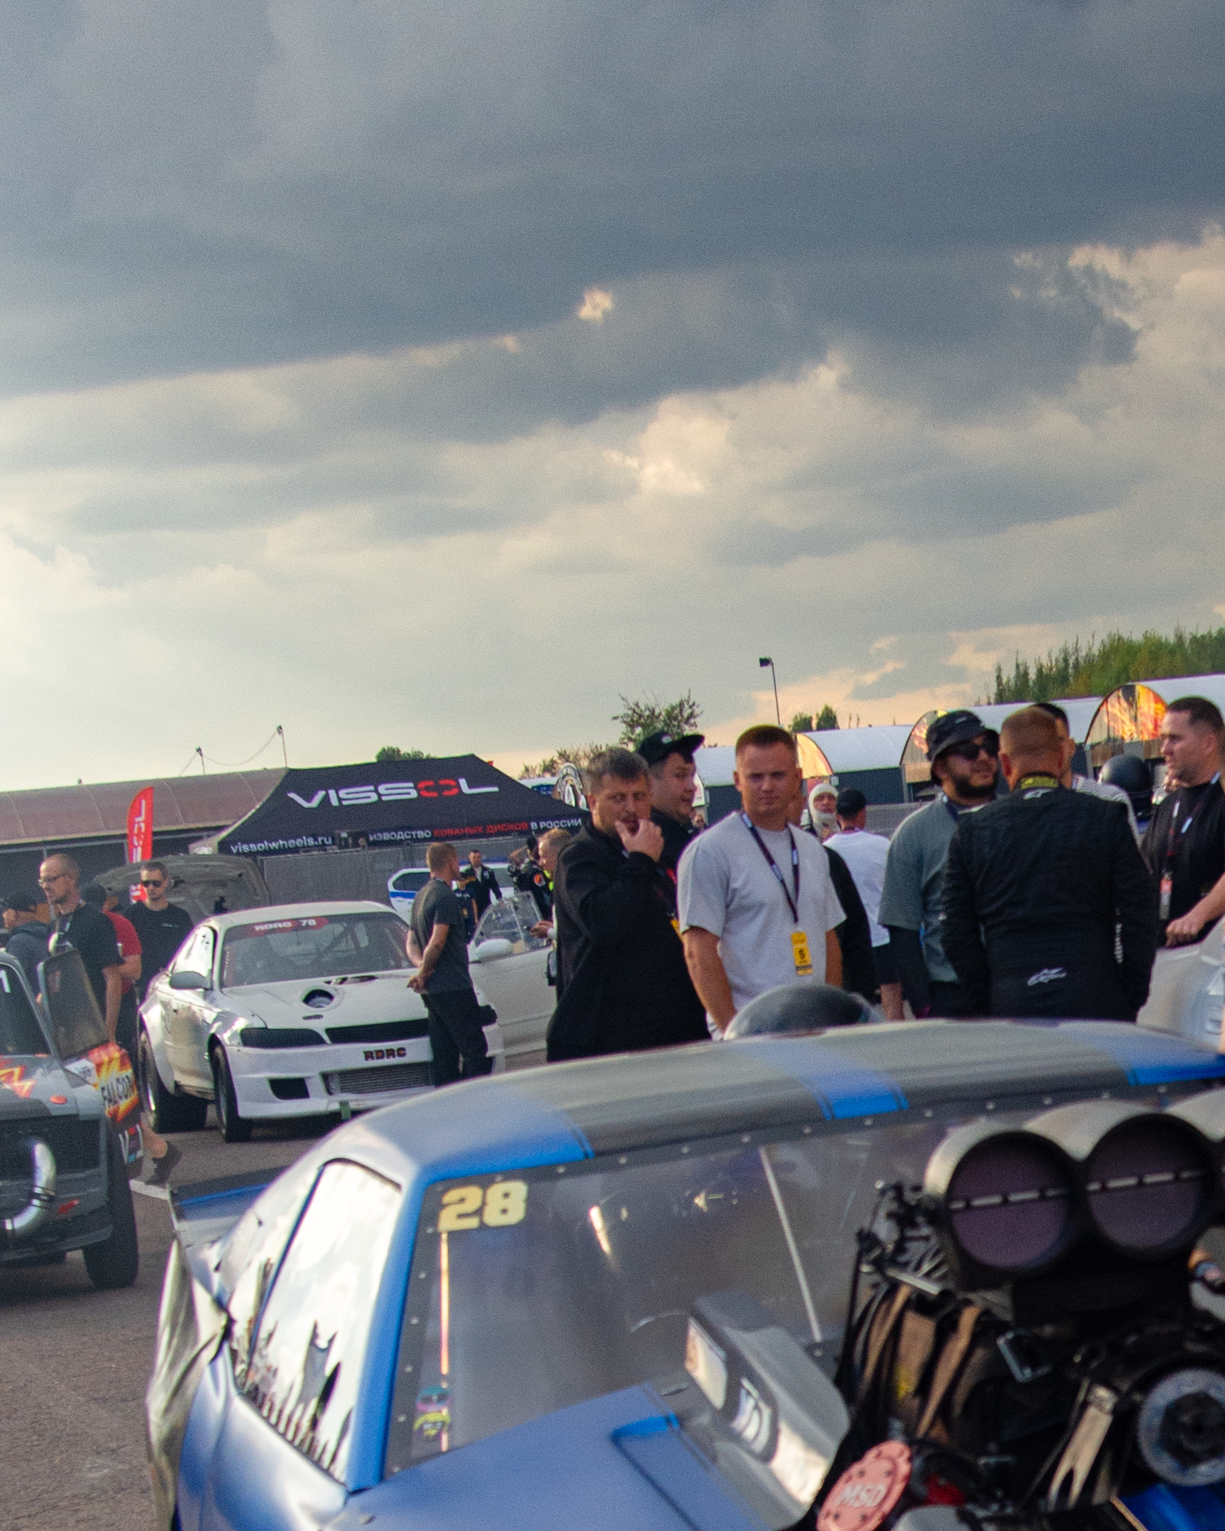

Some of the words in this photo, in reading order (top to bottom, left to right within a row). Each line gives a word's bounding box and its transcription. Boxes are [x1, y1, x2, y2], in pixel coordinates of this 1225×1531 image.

[287, 777, 499, 808] VISSOL
[368, 829, 432, 842] ИЗВОДСТВО
[539, 818, 582, 829] РОССИИ
[230, 836, 332, 854] vissolwheels.ru
[363, 1047, 407, 1061] RDRC
[437, 1180, 529, 1233] 28
